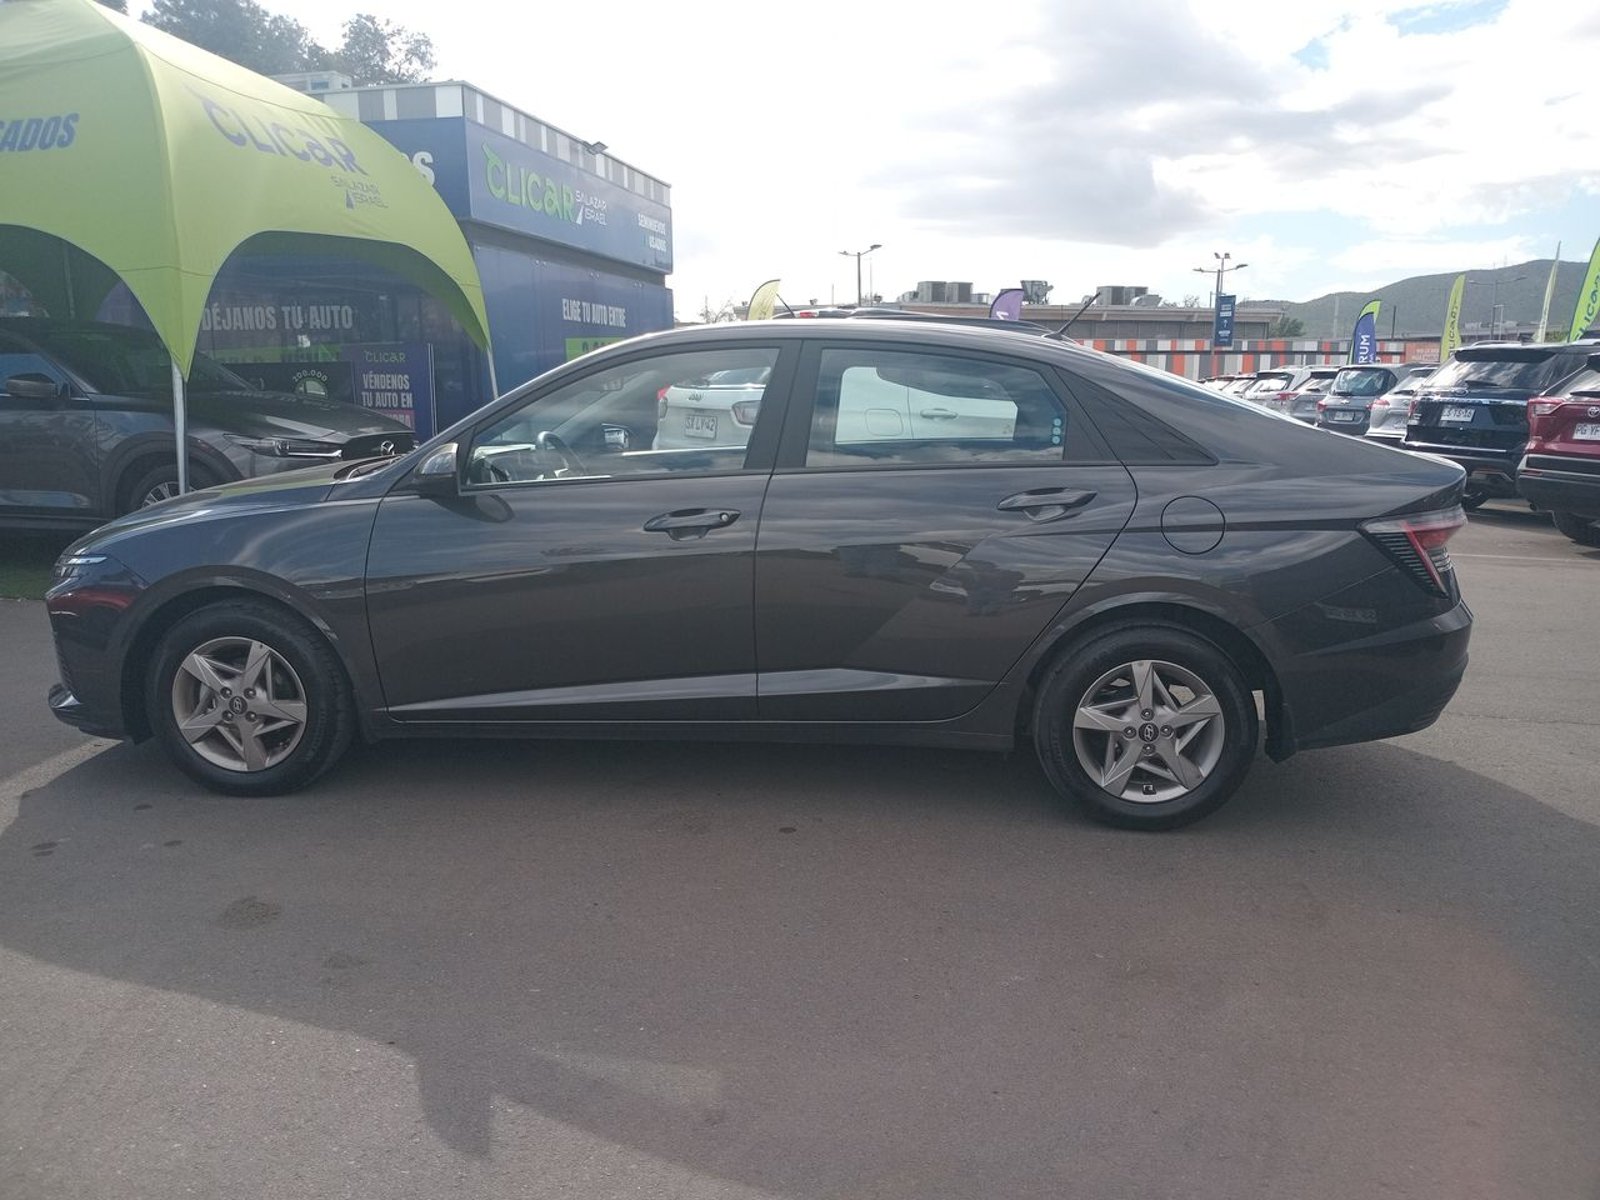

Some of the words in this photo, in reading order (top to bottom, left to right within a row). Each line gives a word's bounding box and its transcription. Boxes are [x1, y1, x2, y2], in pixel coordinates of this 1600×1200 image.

[0, 113, 79, 152] ADOS
[201, 303, 277, 331] DÉJANOS
[309, 305, 353, 330] AUTO
[562, 298, 581, 322] ELIGE
[582, 302, 591, 323] TU
[592, 303, 607, 325] AUTO
[608, 306, 626, 328] ENTRE
[362, 370, 410, 390] VÉNDENOS
[361, 391, 373, 407] TU
[375, 391, 399, 408] AUTO
[401, 392, 414, 408] EN
